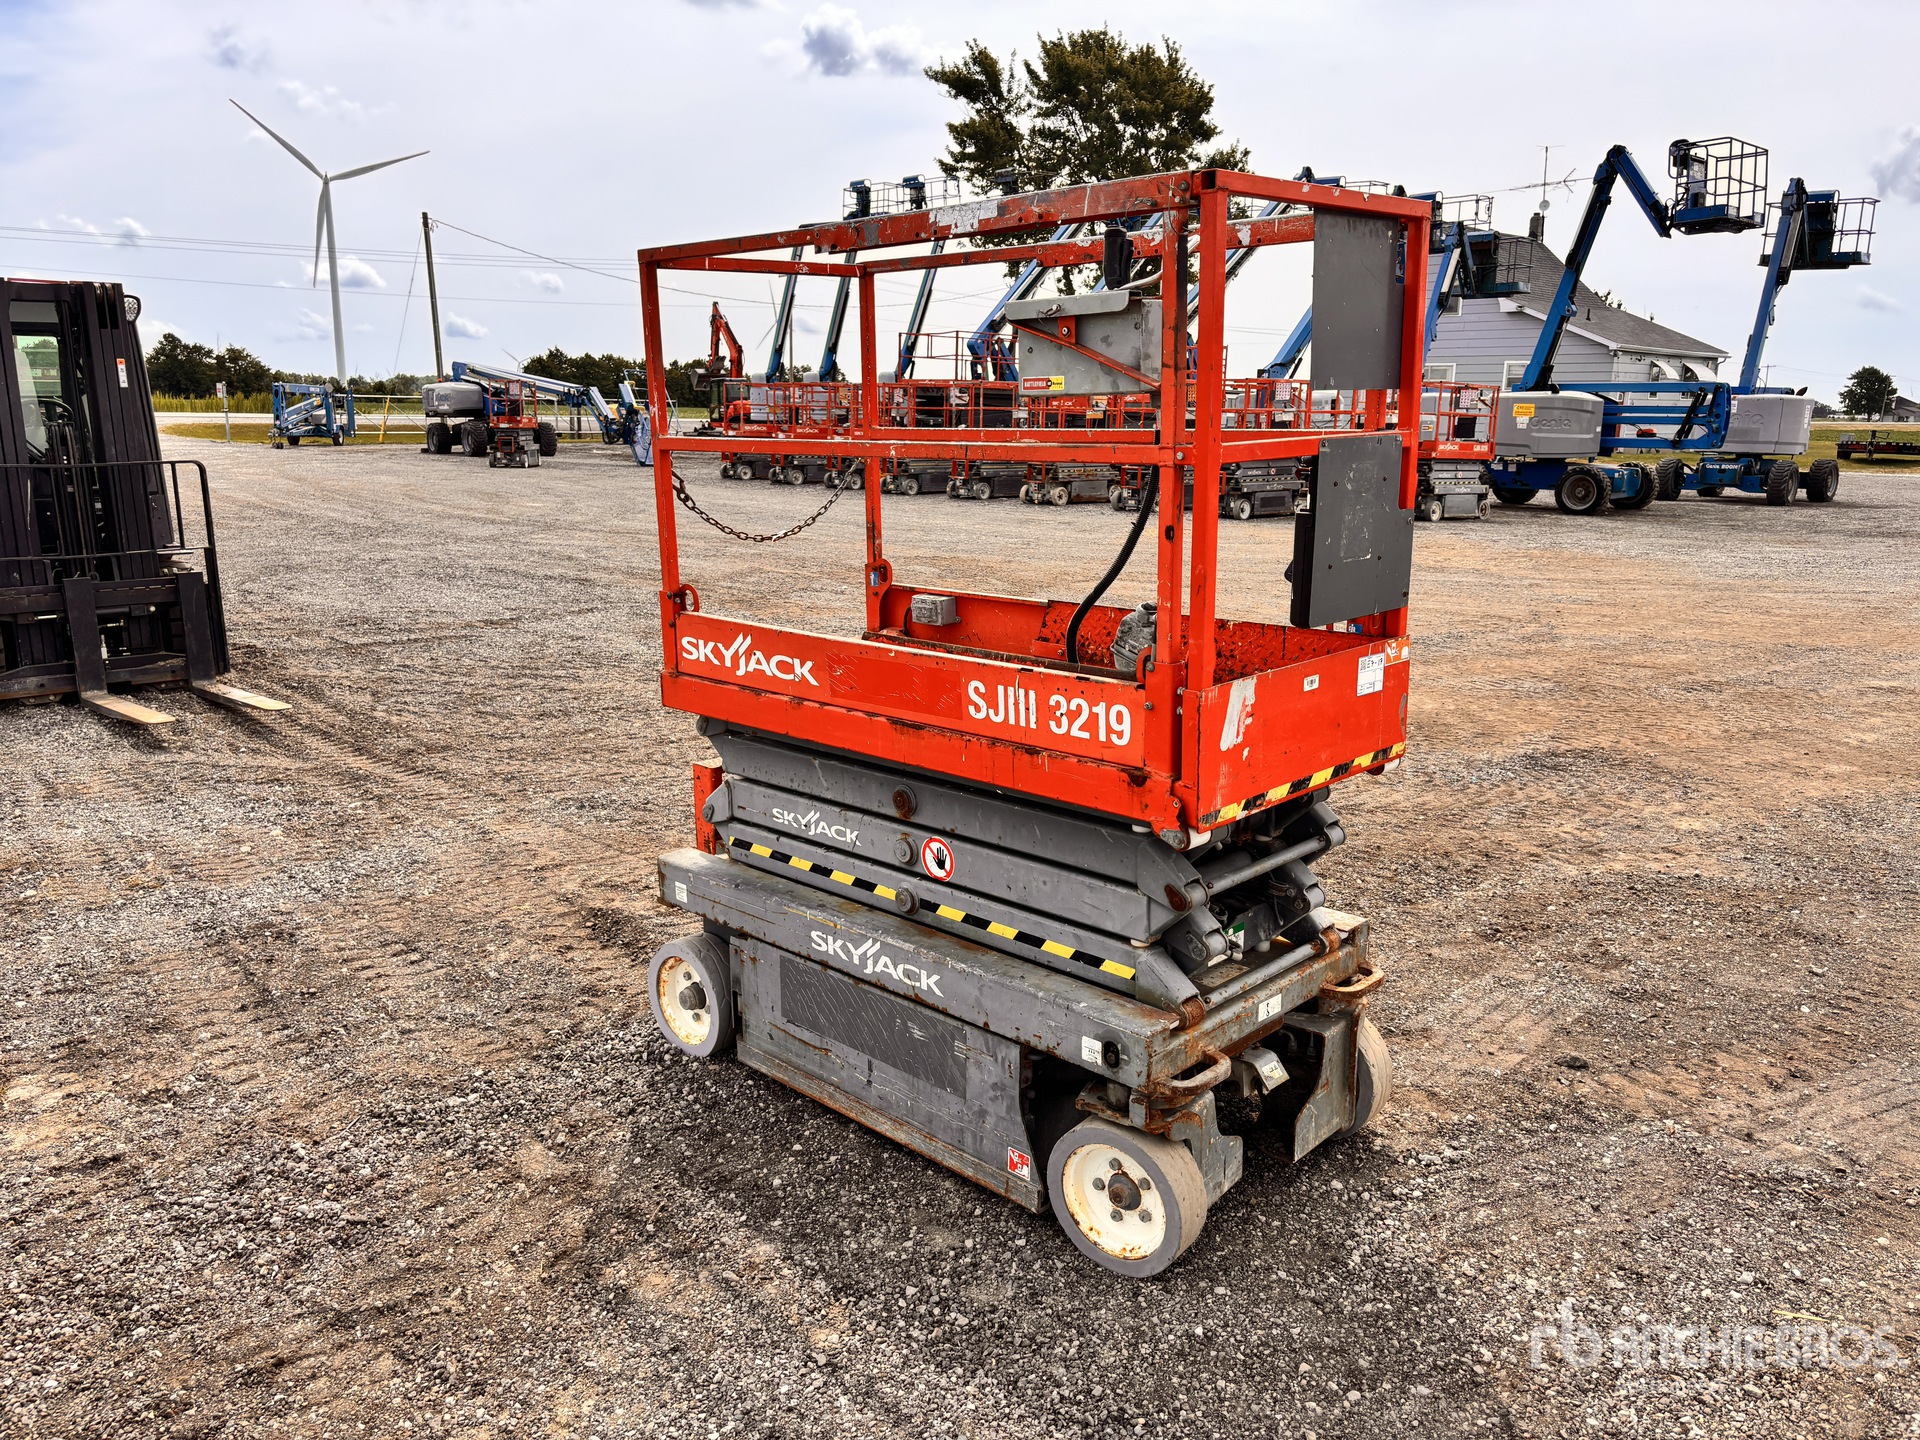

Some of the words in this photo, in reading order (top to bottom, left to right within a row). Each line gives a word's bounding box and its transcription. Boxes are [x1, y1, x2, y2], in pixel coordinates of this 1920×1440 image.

[680, 632, 820, 687] SKYJACK
[1048, 694, 1131, 746] 3219
[772, 807, 862, 847] SKYJACK
[810, 930, 945, 998] SKYJACK
